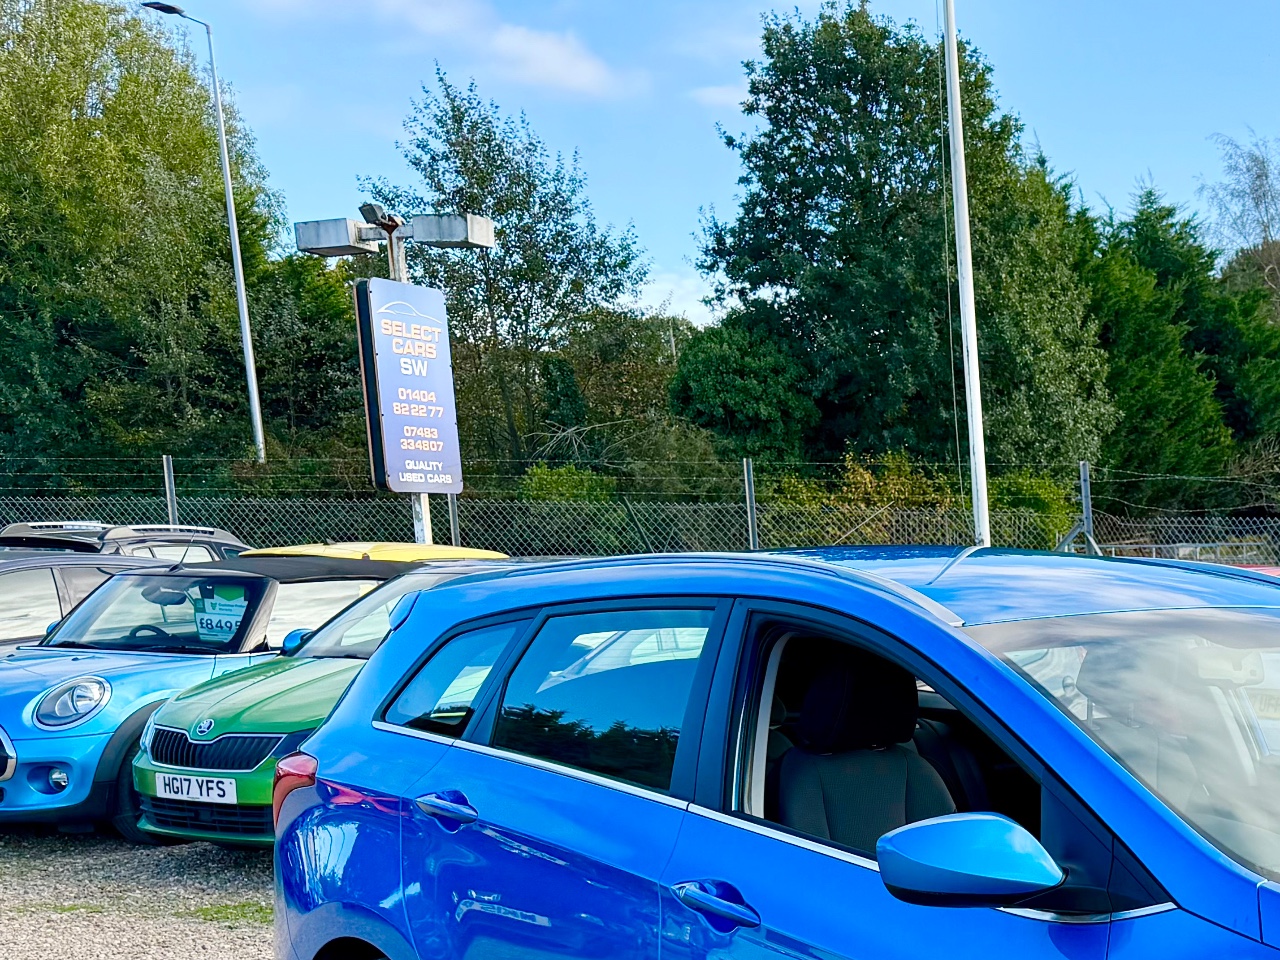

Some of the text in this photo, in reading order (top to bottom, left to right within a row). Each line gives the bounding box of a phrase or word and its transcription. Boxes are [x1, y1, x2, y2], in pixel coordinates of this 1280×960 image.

[381, 318, 441, 343] SELECT
[392, 338, 437, 359] CARS
[400, 357, 428, 377] SW
[398, 387, 437, 403] 01404
[403, 426, 438, 438] 07483
[400, 438, 444, 452] 334807
[405, 459, 443, 471] QUALITY
[399, 472, 453, 484] USED CARS
[163, 776, 226, 798] HG17 YFS
